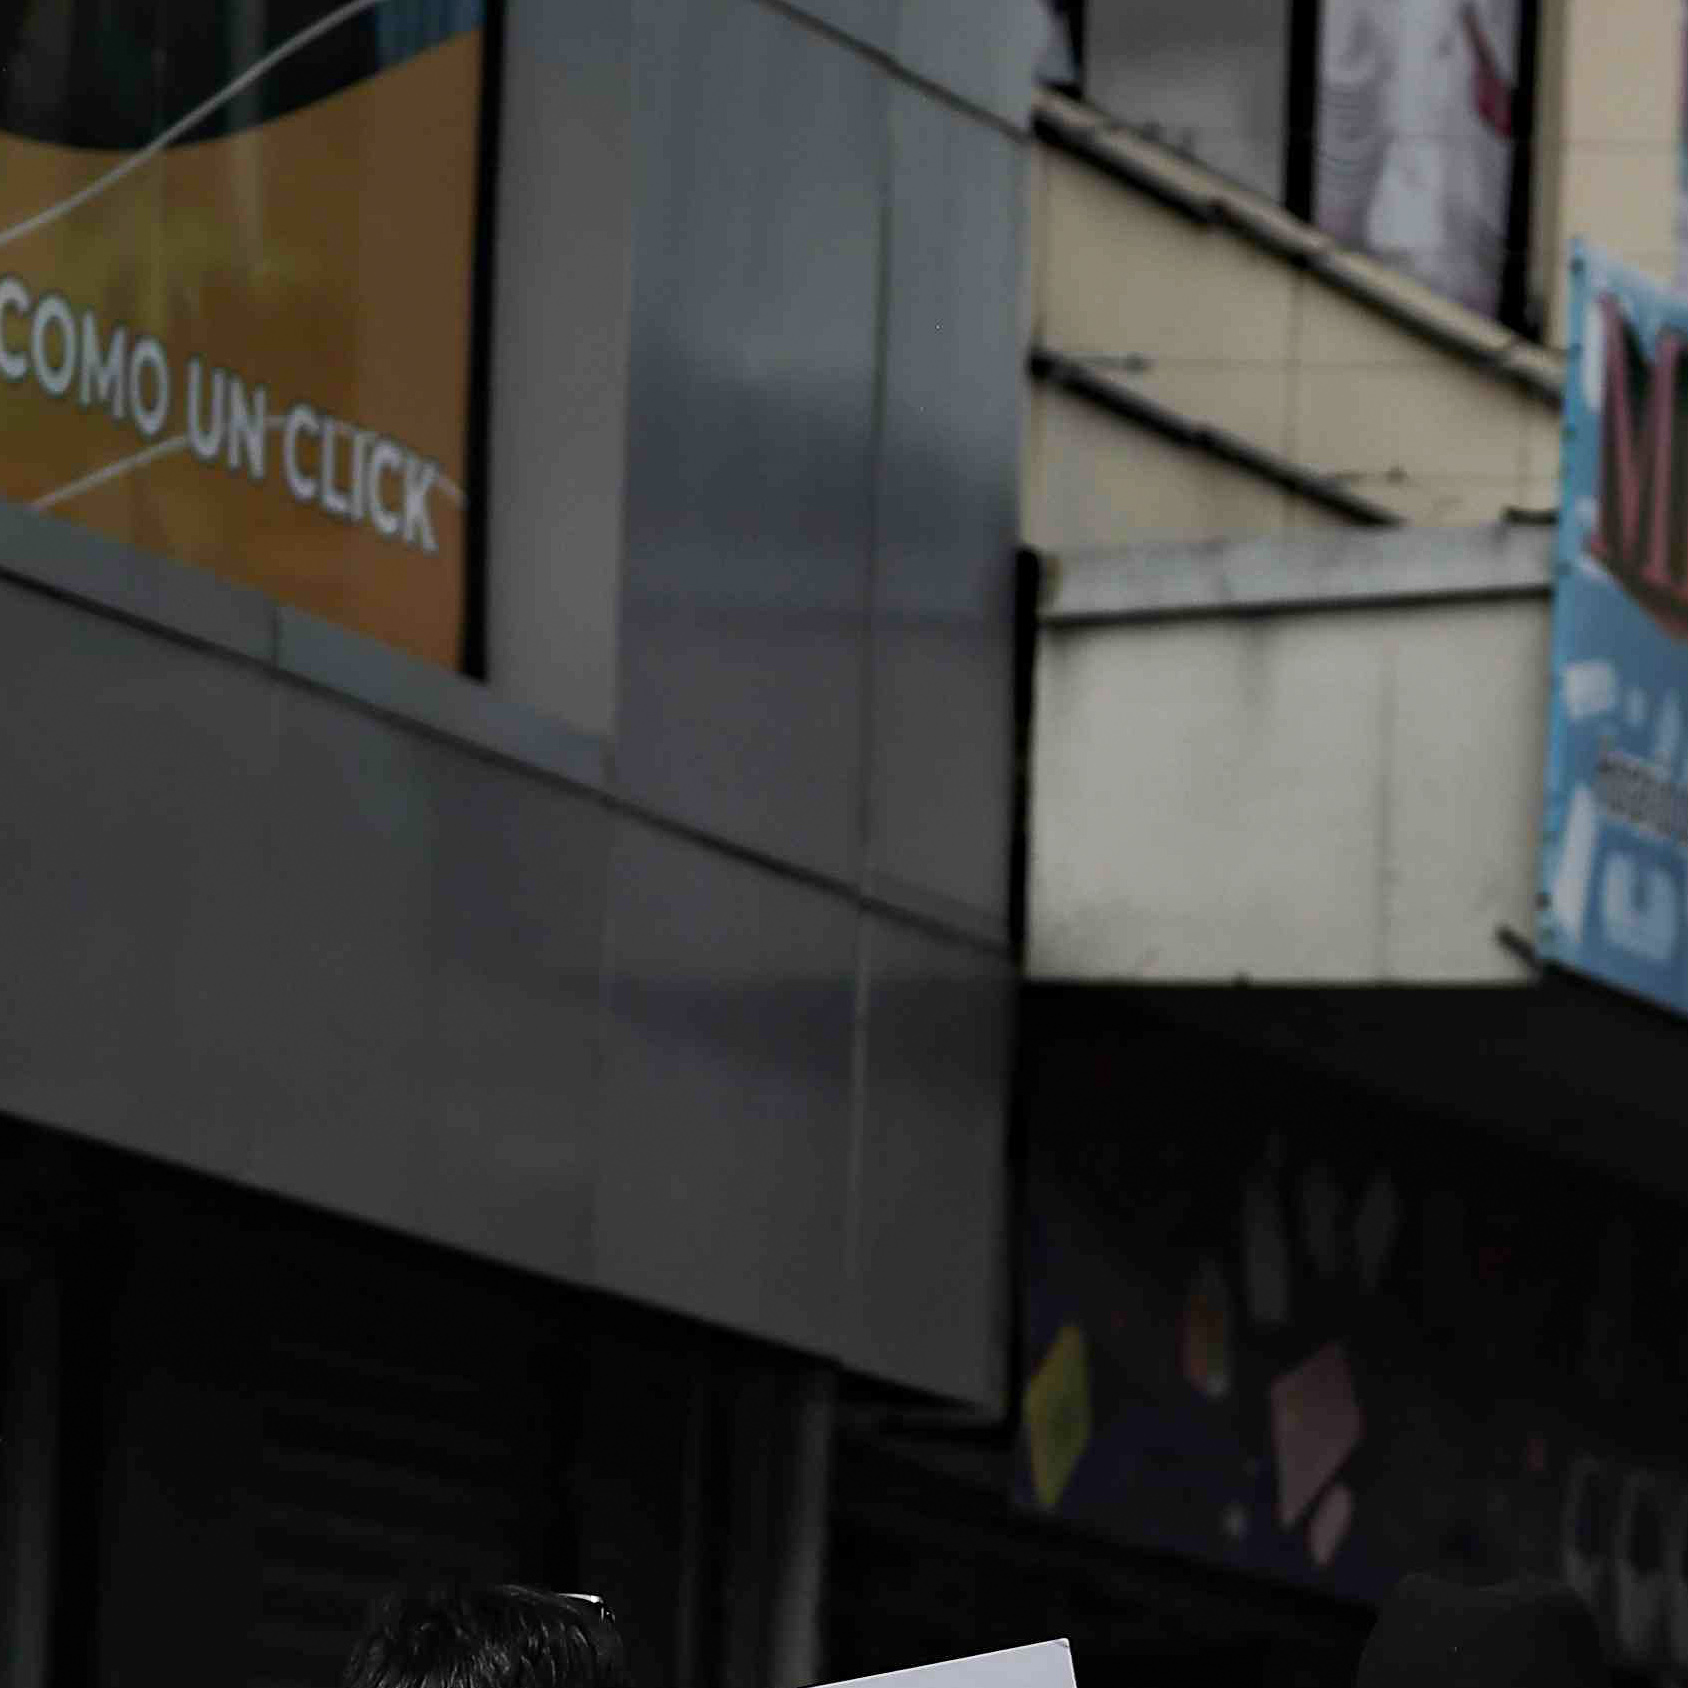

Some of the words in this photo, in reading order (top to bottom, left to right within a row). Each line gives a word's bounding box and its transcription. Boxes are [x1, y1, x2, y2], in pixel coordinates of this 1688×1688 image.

[0, 276, 169, 436] COMO
[187, 359, 268, 480] UN
[285, 403, 439, 554] CLICK
